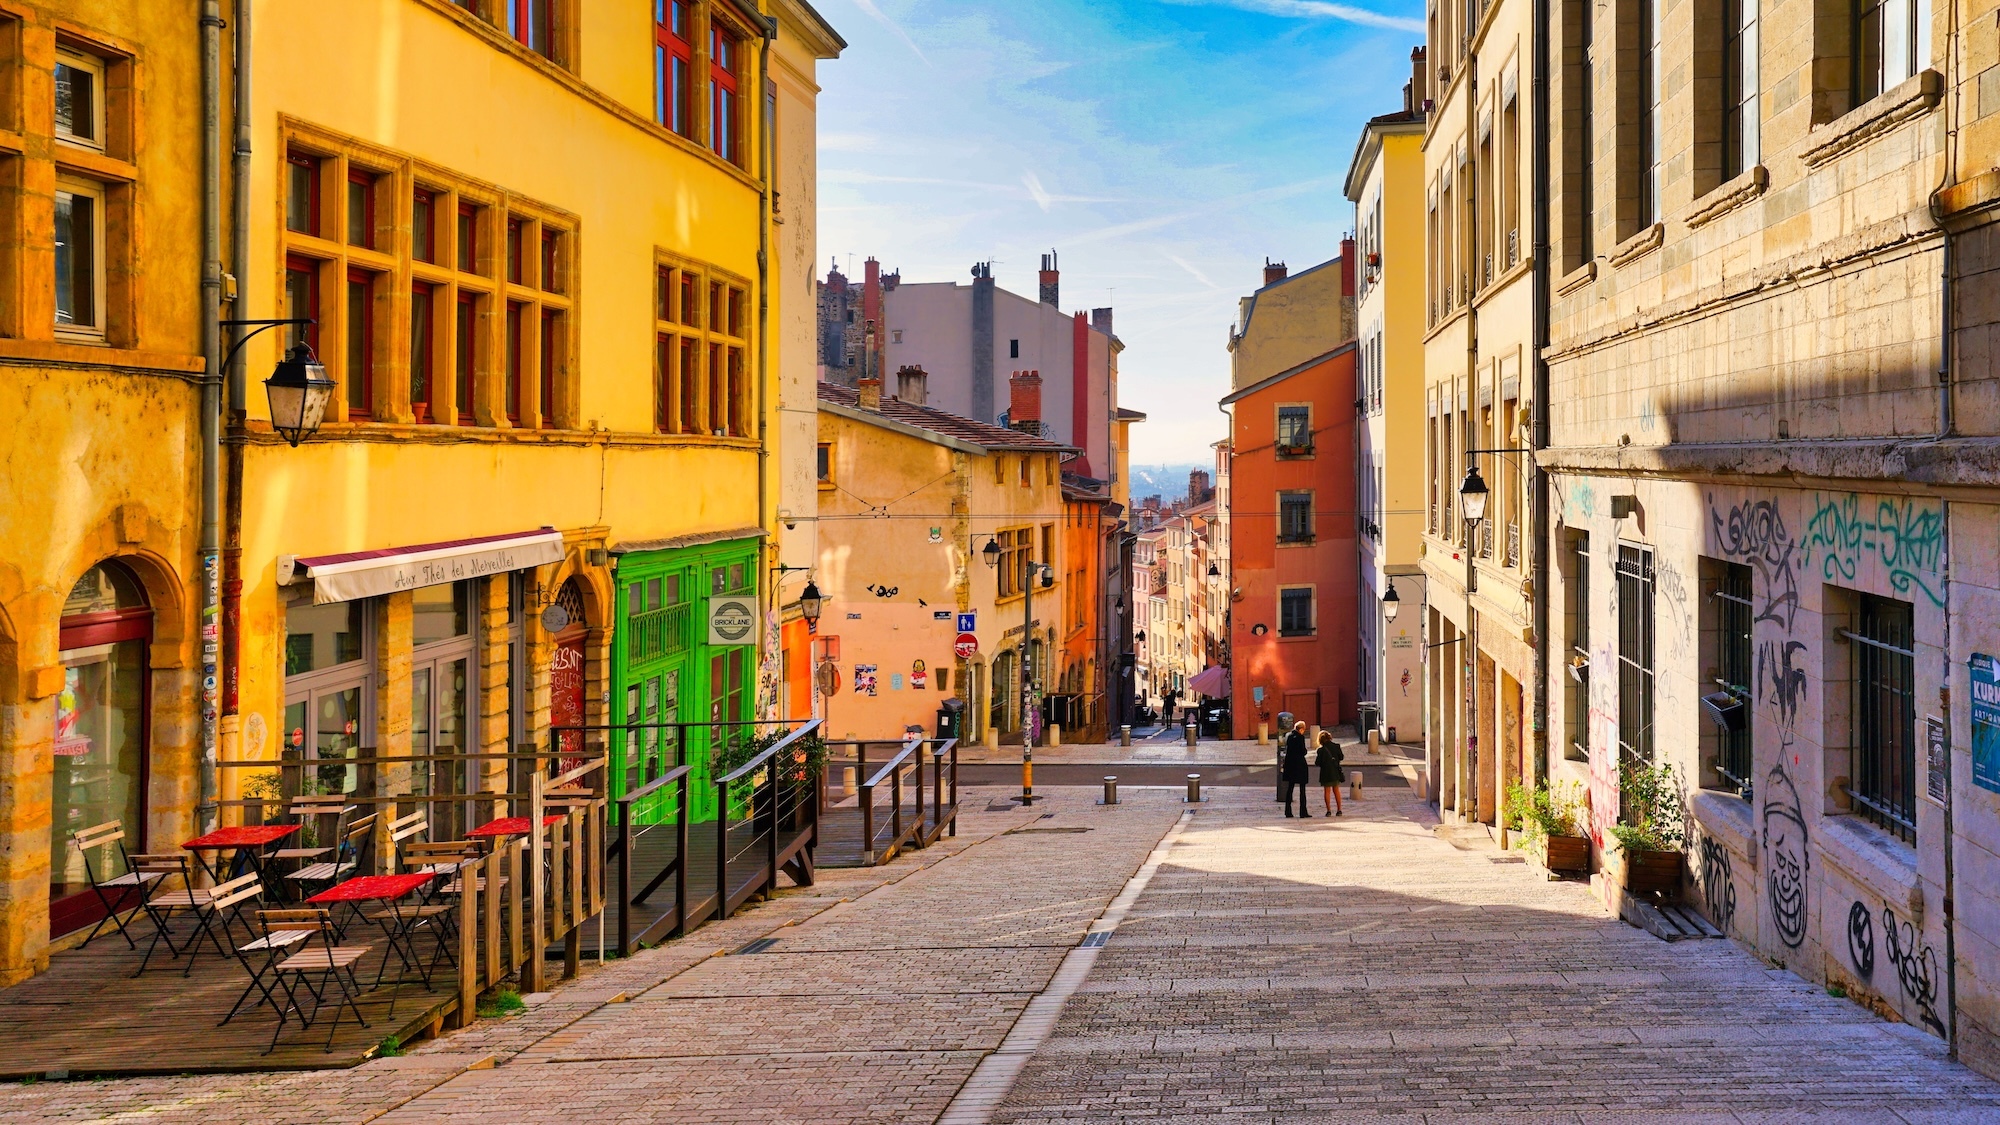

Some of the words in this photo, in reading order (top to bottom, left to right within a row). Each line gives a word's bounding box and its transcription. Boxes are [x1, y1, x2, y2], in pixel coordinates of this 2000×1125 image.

[394, 570, 417, 588] Aux
[422, 561, 445, 584] Thés
[451, 560, 465, 579] des
[470, 551, 515, 575] Merveilles
